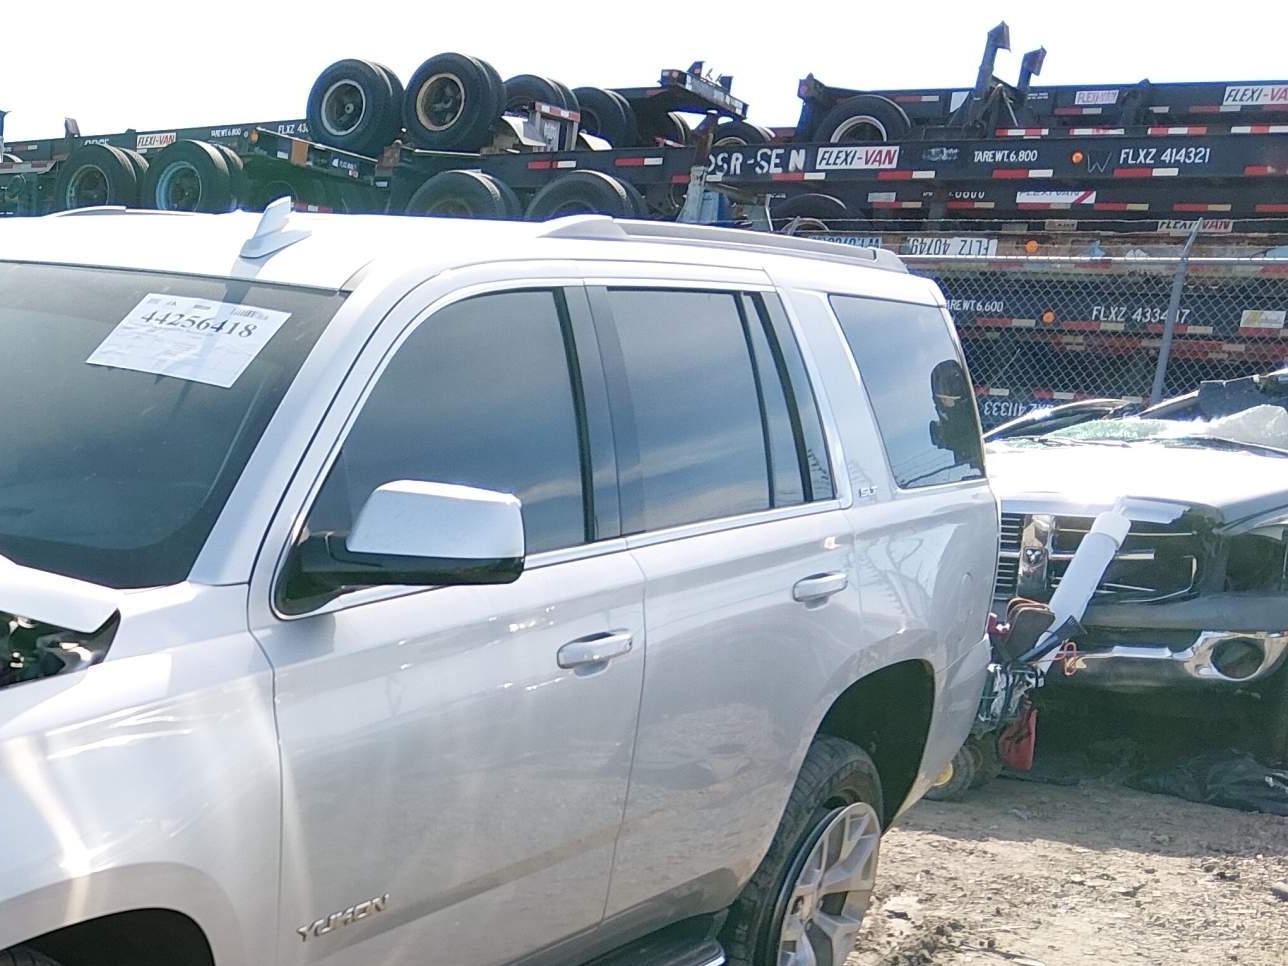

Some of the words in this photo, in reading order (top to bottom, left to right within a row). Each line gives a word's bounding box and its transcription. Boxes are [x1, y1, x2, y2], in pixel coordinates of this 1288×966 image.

[1225, 87, 1288, 102] FLEXI-VA
[818, 149, 897, 167] FLEXI-VAN
[1119, 148, 1157, 164] FLXZ
[1160, 147, 1210, 164] 414321
[907, 238, 952, 256] 40749
[1092, 305, 1127, 321] FLXZ
[140, 310, 258, 338] 44256418
